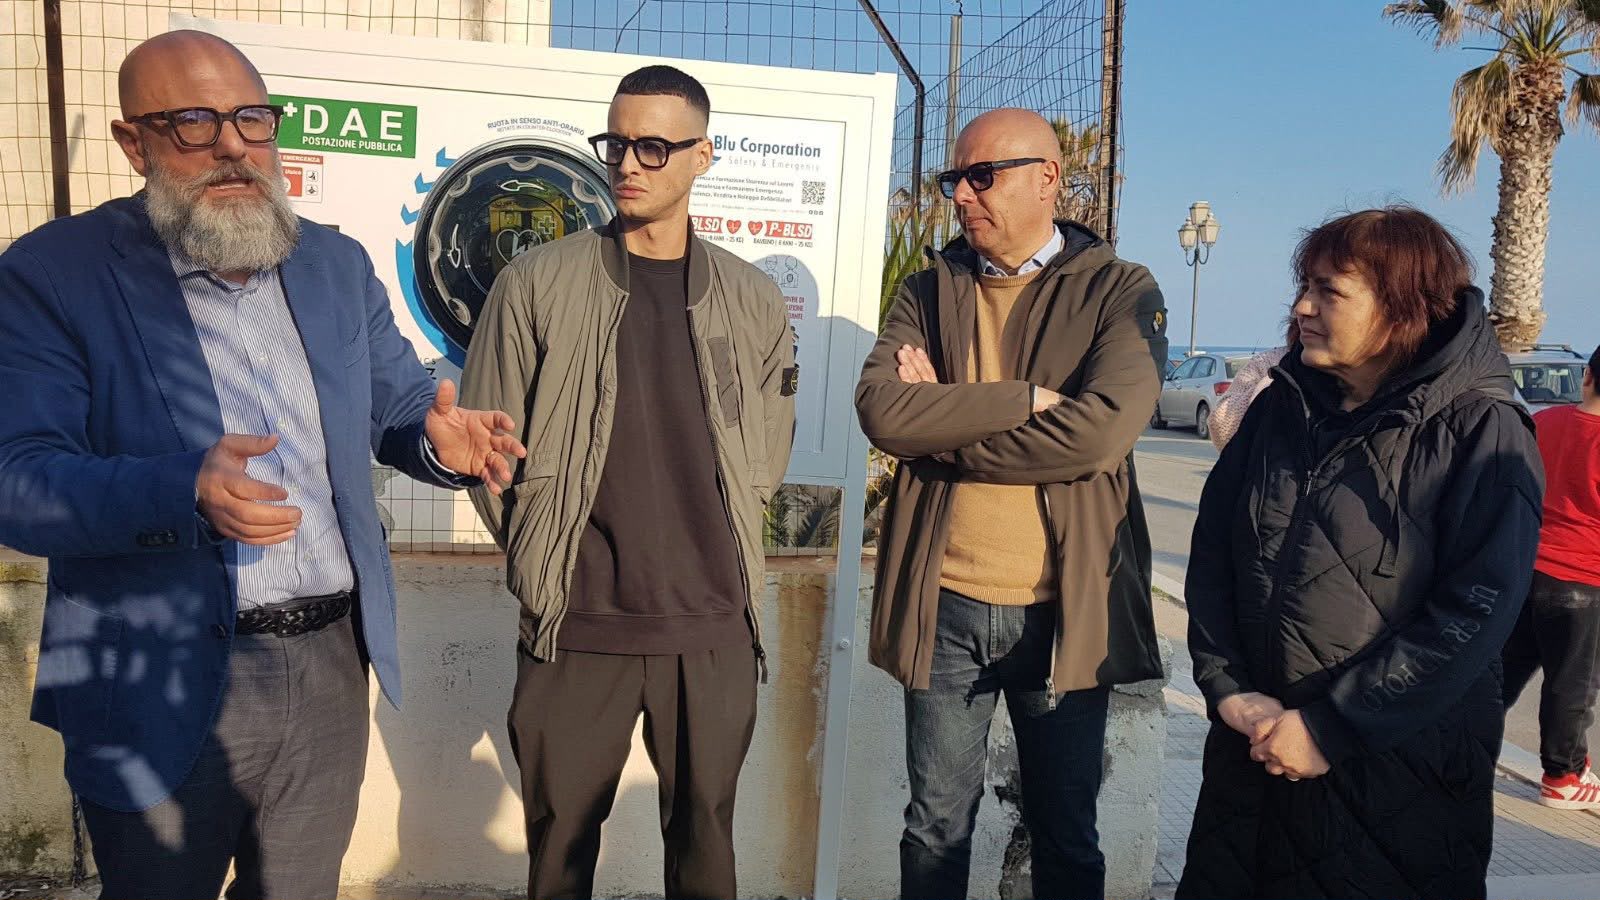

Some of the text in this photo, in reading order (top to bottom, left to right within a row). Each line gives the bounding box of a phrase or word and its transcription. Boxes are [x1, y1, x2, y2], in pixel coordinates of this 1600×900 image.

[303, 104, 403, 140] DAE
[487, 119, 510, 129] RUOTA
[519, 117, 542, 125] SENSO
[302, 136, 402, 152] POSTAZIONE PUBBLICA
[713, 135, 821, 159] Blu Corporation
[728, 155, 757, 169] Safety
[770, 223, 812, 238] P-BLSD
